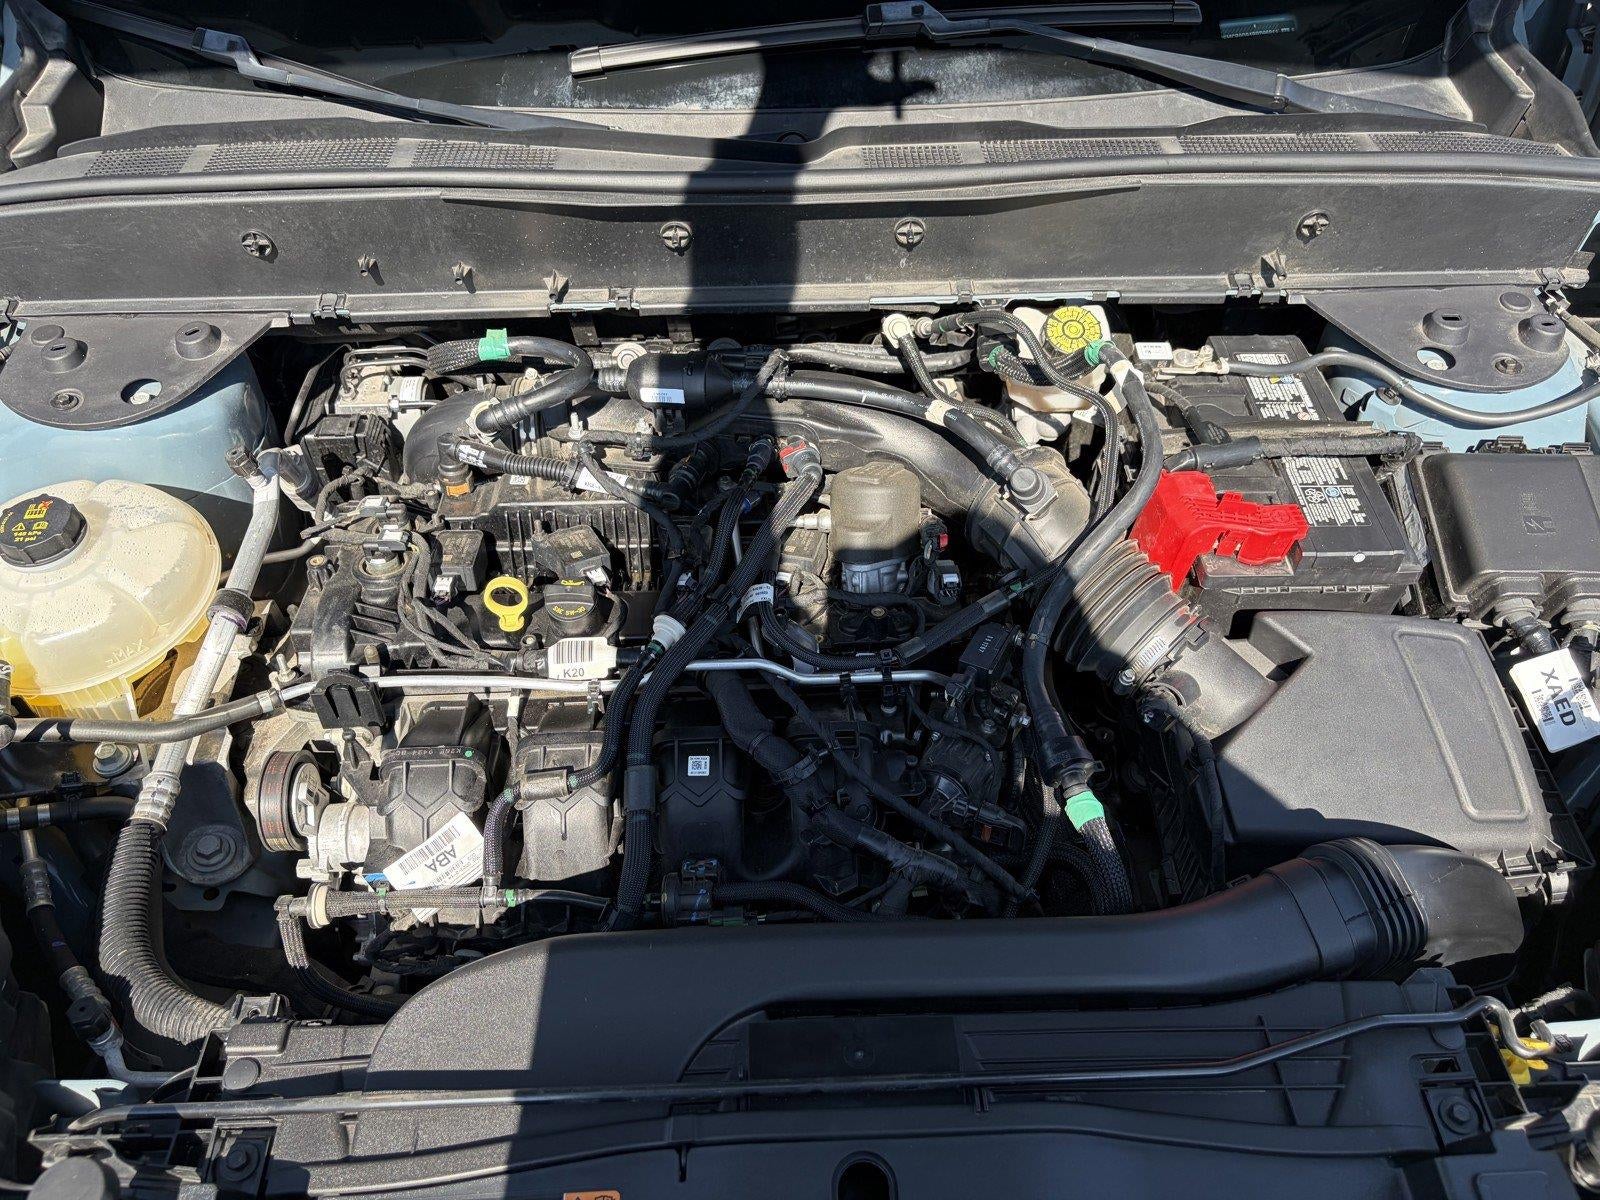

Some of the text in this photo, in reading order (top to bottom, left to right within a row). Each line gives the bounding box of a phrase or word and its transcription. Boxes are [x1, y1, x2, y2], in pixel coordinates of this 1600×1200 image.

[562, 667, 585, 679] K20
[1540, 666, 1577, 727] XAED
[424, 844, 458, 874] ABA
